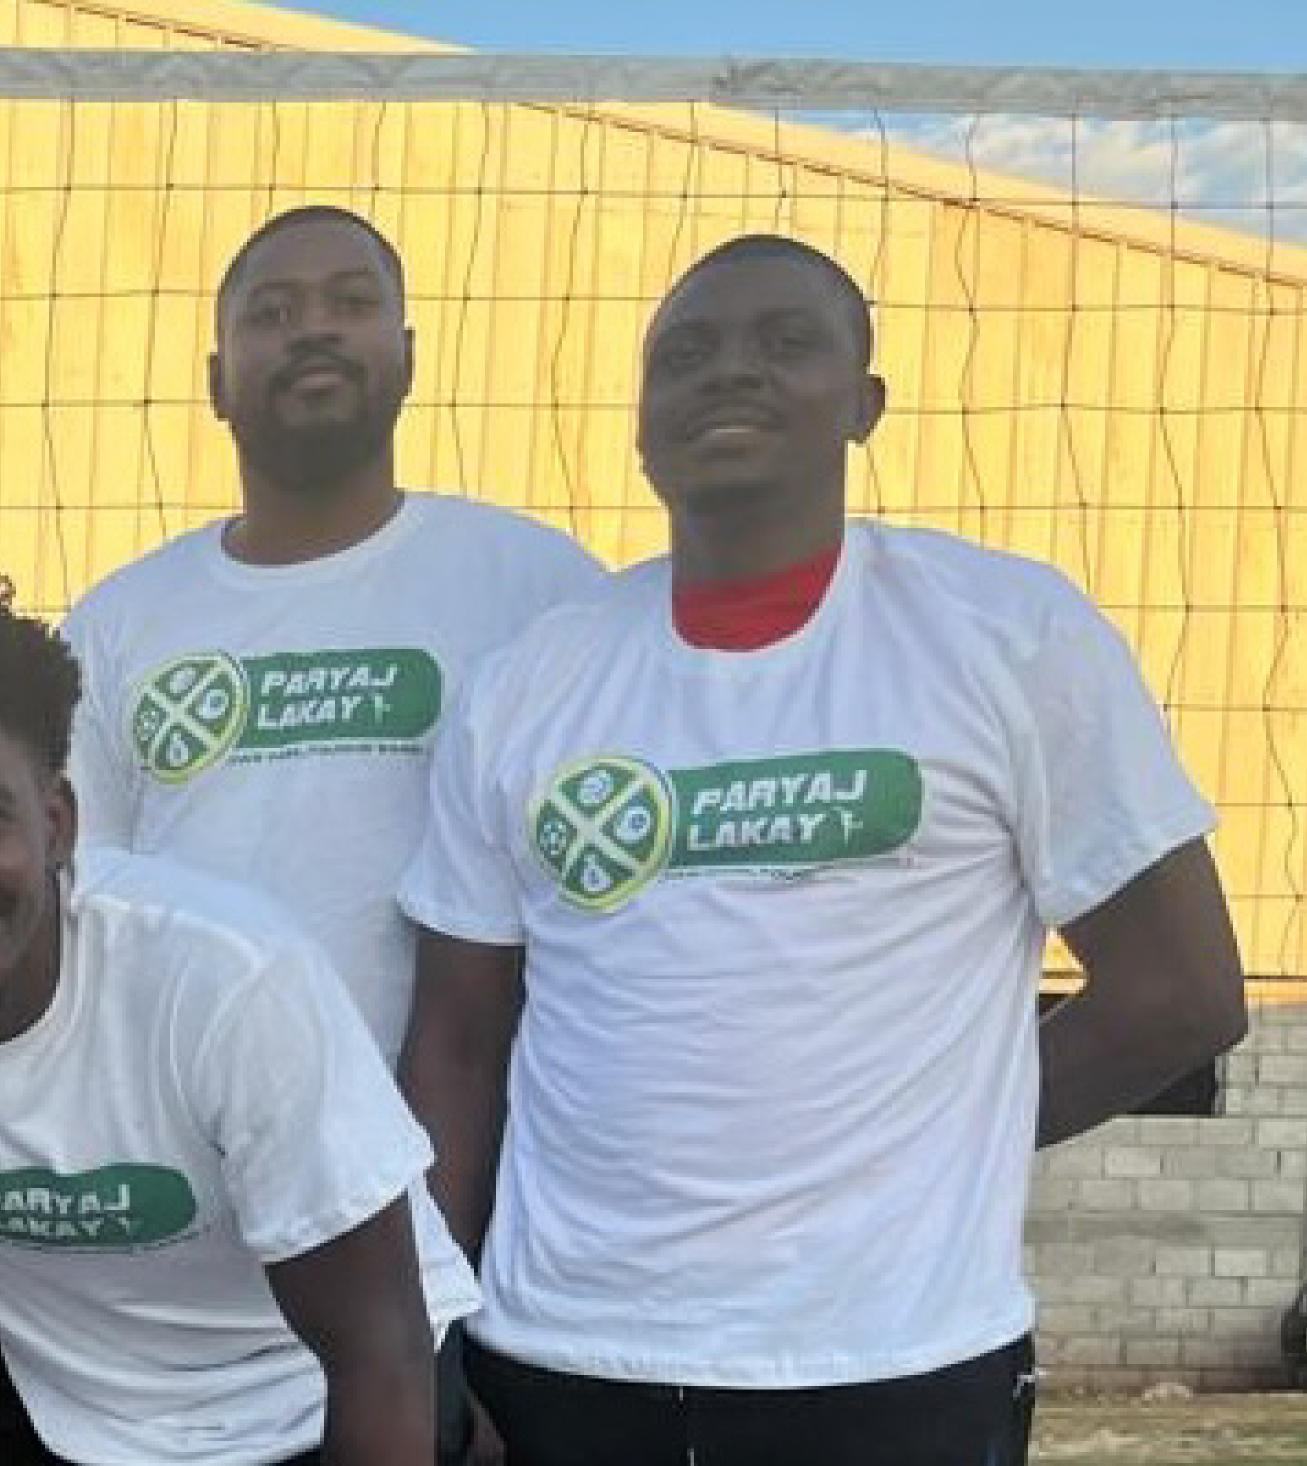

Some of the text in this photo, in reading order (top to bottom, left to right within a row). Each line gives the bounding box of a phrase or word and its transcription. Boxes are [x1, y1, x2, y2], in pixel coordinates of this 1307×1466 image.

[261, 663, 398, 694] PARYAJ
[257, 696, 362, 730] LAKAY
[691, 769, 867, 816] PARYAJ
[688, 813, 827, 851] LAKAY
